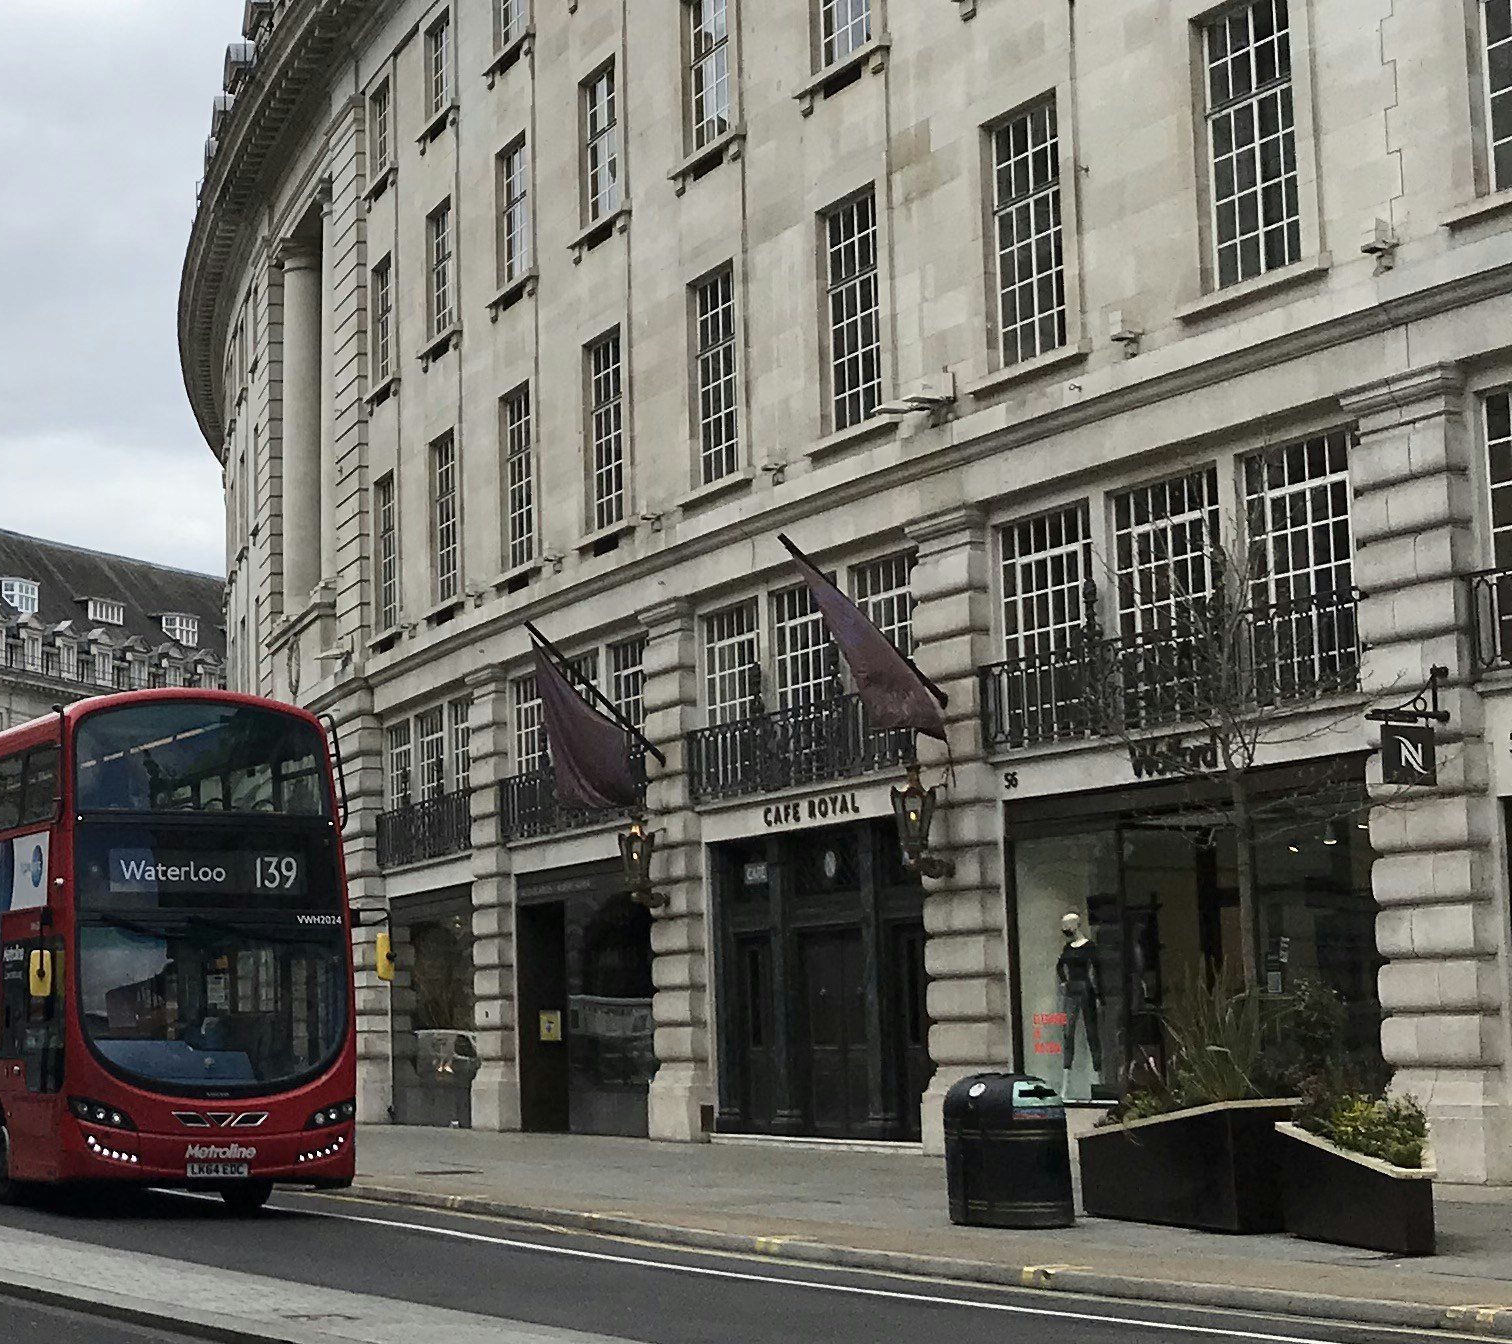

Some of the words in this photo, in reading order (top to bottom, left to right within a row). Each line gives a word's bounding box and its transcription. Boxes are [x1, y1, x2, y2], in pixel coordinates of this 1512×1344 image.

[1004, 771, 1018, 789] 56
[763, 802, 801, 827] CAFE
[808, 792, 860, 820] ROYAL
[120, 859, 227, 882] Waterloo
[255, 856, 299, 889] 139
[296, 914, 342, 925] VWH2024
[185, 1142, 257, 1160] Metroline
[191, 1163, 220, 1175] LK64
